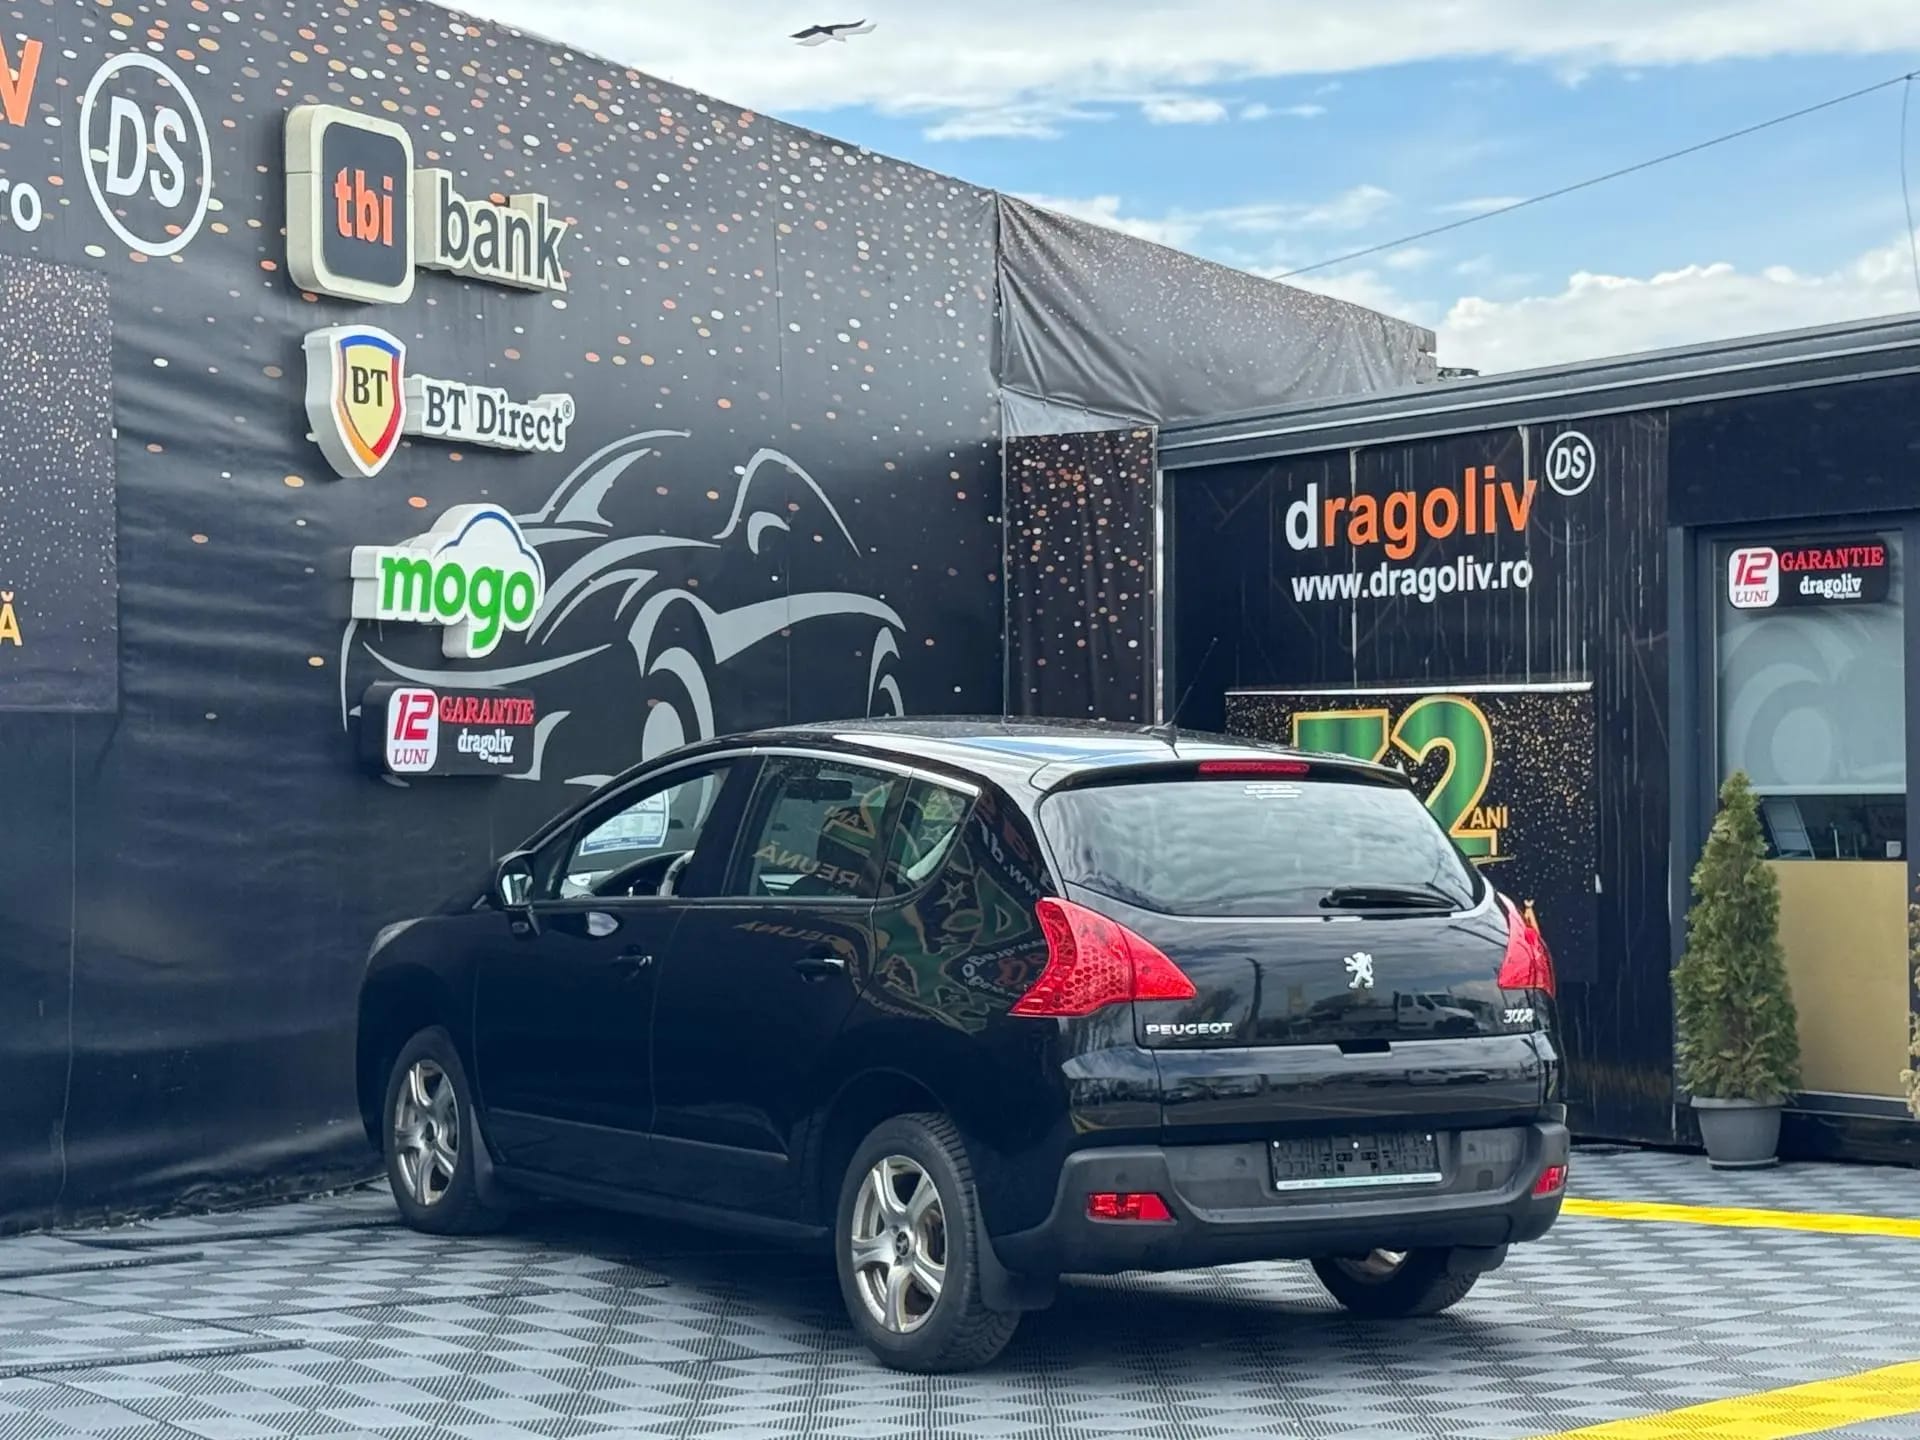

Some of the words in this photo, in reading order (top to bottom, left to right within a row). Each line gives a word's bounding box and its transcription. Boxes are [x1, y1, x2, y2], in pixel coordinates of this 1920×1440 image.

[105, 96, 187, 208] DS
[334, 166, 394, 247] tbi
[440, 178, 566, 288] bank
[351, 365, 388, 407] BT
[425, 385, 466, 431] BT
[1285, 465, 1537, 560] dragoliv
[1553, 444, 1587, 480] DS
[1291, 554, 1534, 603] www.dragoliv.ro
[1734, 551, 1773, 586] 12
[1779, 546, 1884, 572] GARANTIE
[1735, 590, 1769, 603] LUNI
[1800, 573, 1862, 599] dragoliv
[381, 556, 535, 649] mogo
[393, 694, 435, 741] 12
[439, 696, 535, 725] GARANTIE
[393, 748, 430, 765] LUNI
[457, 728, 514, 761] dragoliv
[1470, 806, 1508, 829] ANI
[1145, 1022, 1233, 1036] PEUGEOT
